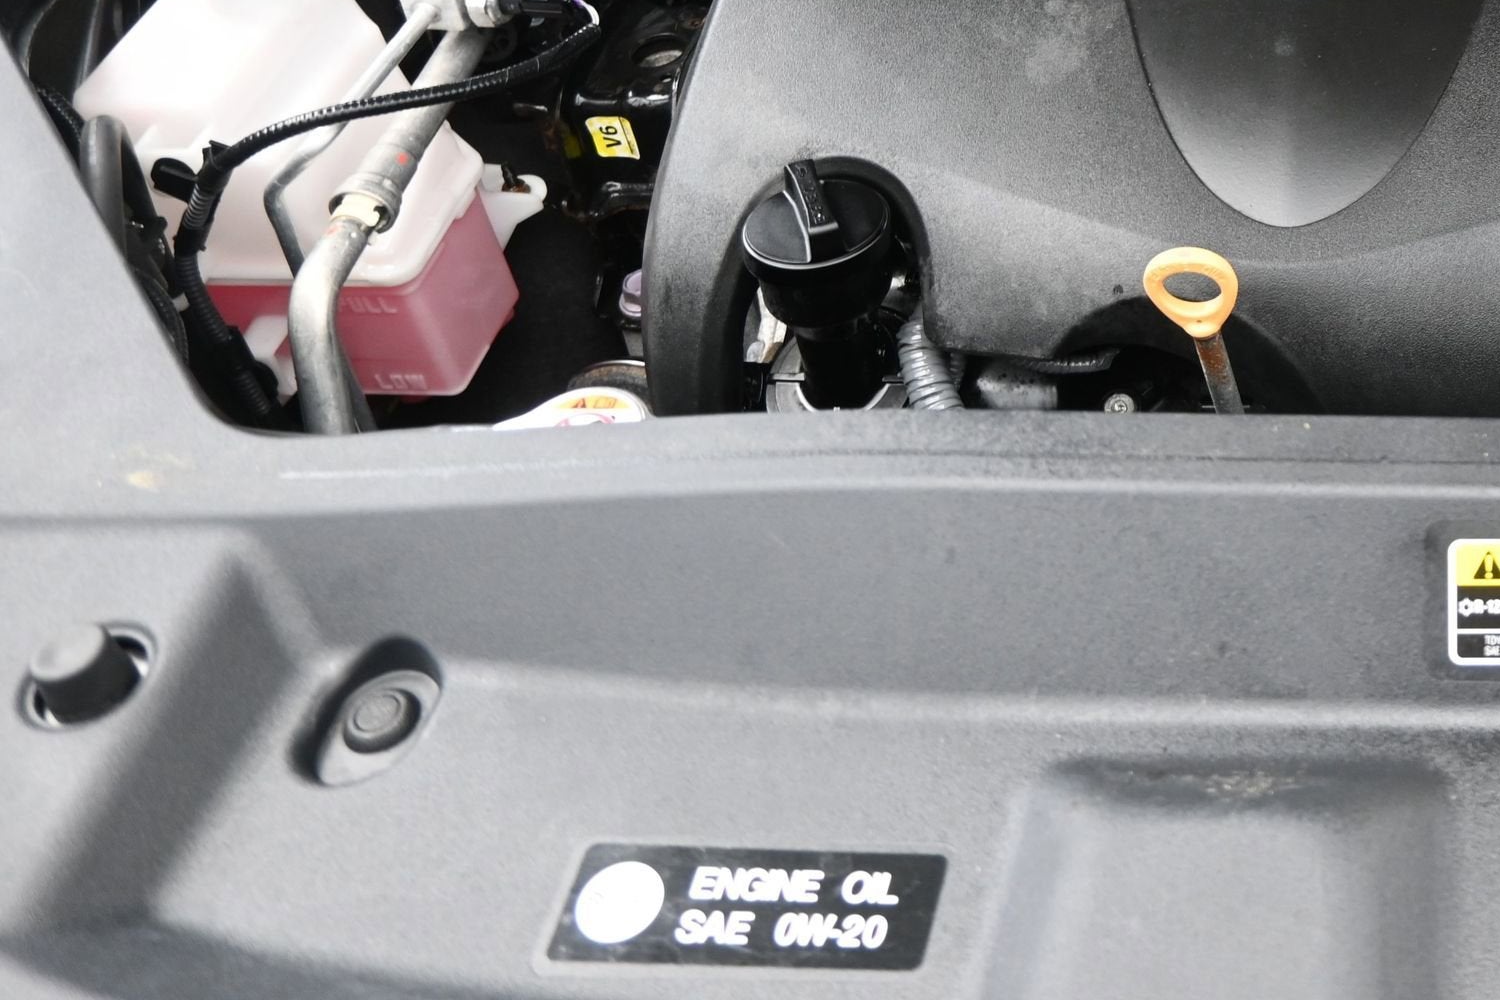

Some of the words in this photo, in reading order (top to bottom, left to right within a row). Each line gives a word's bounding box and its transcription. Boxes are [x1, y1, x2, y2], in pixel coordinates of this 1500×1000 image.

[599, 125, 622, 148] V6
[374, 373, 427, 391] LOW
[1484, 645, 1500, 656] SAE
[688, 866, 825, 903] ENGINE
[841, 870, 899, 905] OIL
[674, 908, 756, 945] SAE
[773, 912, 888, 949] 0W-20
